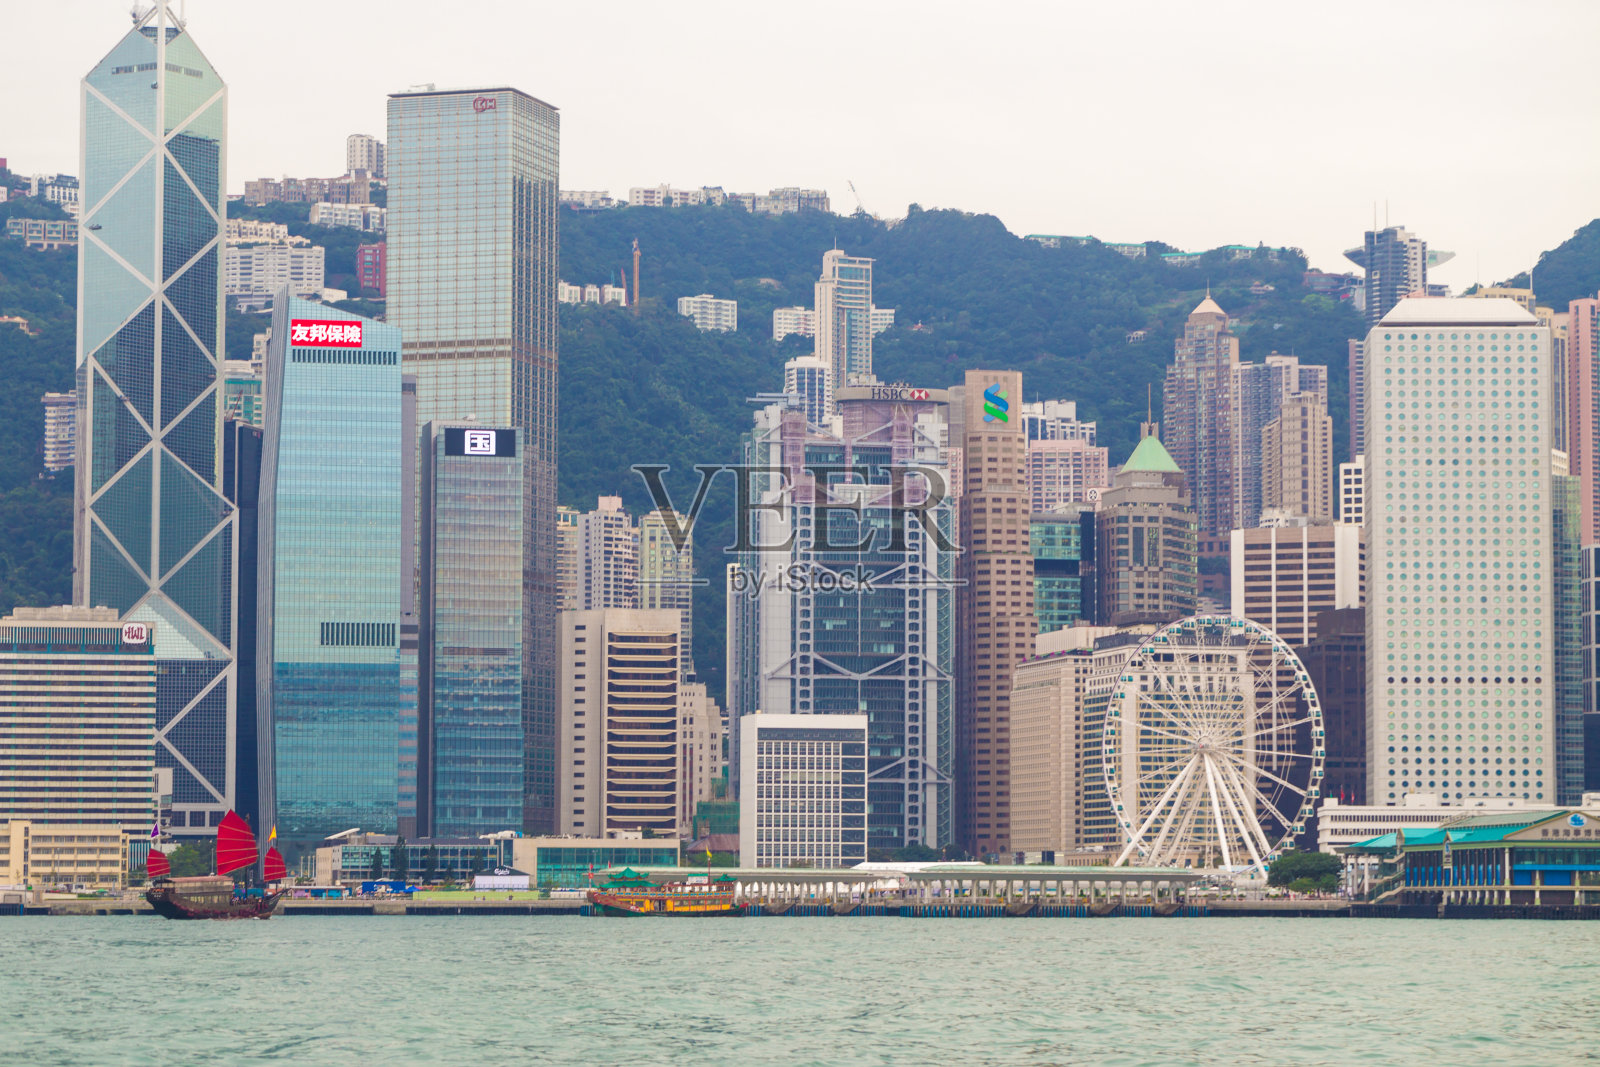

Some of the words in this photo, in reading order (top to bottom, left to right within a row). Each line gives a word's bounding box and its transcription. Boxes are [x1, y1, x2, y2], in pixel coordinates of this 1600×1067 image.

[292, 324, 361, 343] 友邦保險
[871, 387, 908, 400] HSBC
